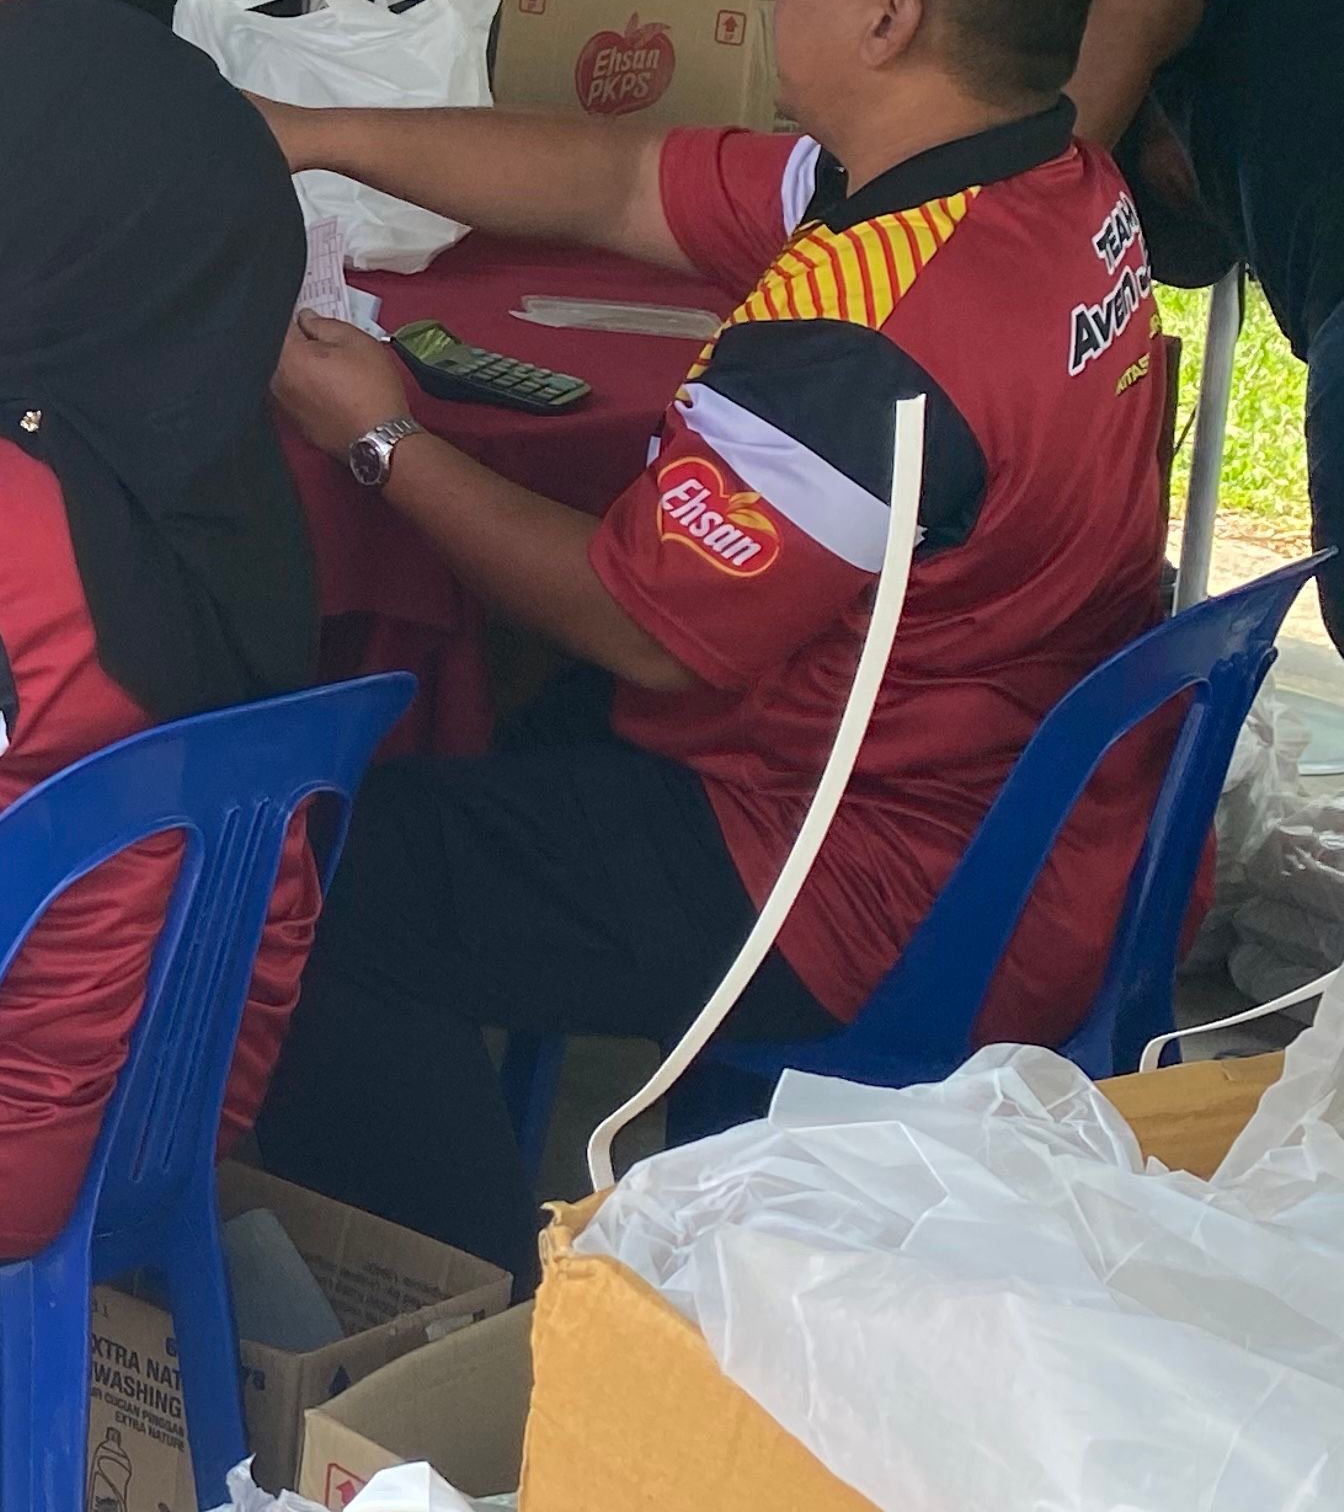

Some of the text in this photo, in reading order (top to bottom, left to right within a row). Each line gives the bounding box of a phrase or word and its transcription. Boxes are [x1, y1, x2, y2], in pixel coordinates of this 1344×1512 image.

[587, 72, 652, 106] PKPS
[592, 46, 660, 77] Ehsan
[660, 478, 762, 567] Ehsan
[91, 1333, 181, 1391] XTRA NAT
[91, 1360, 182, 1419] WASHING
